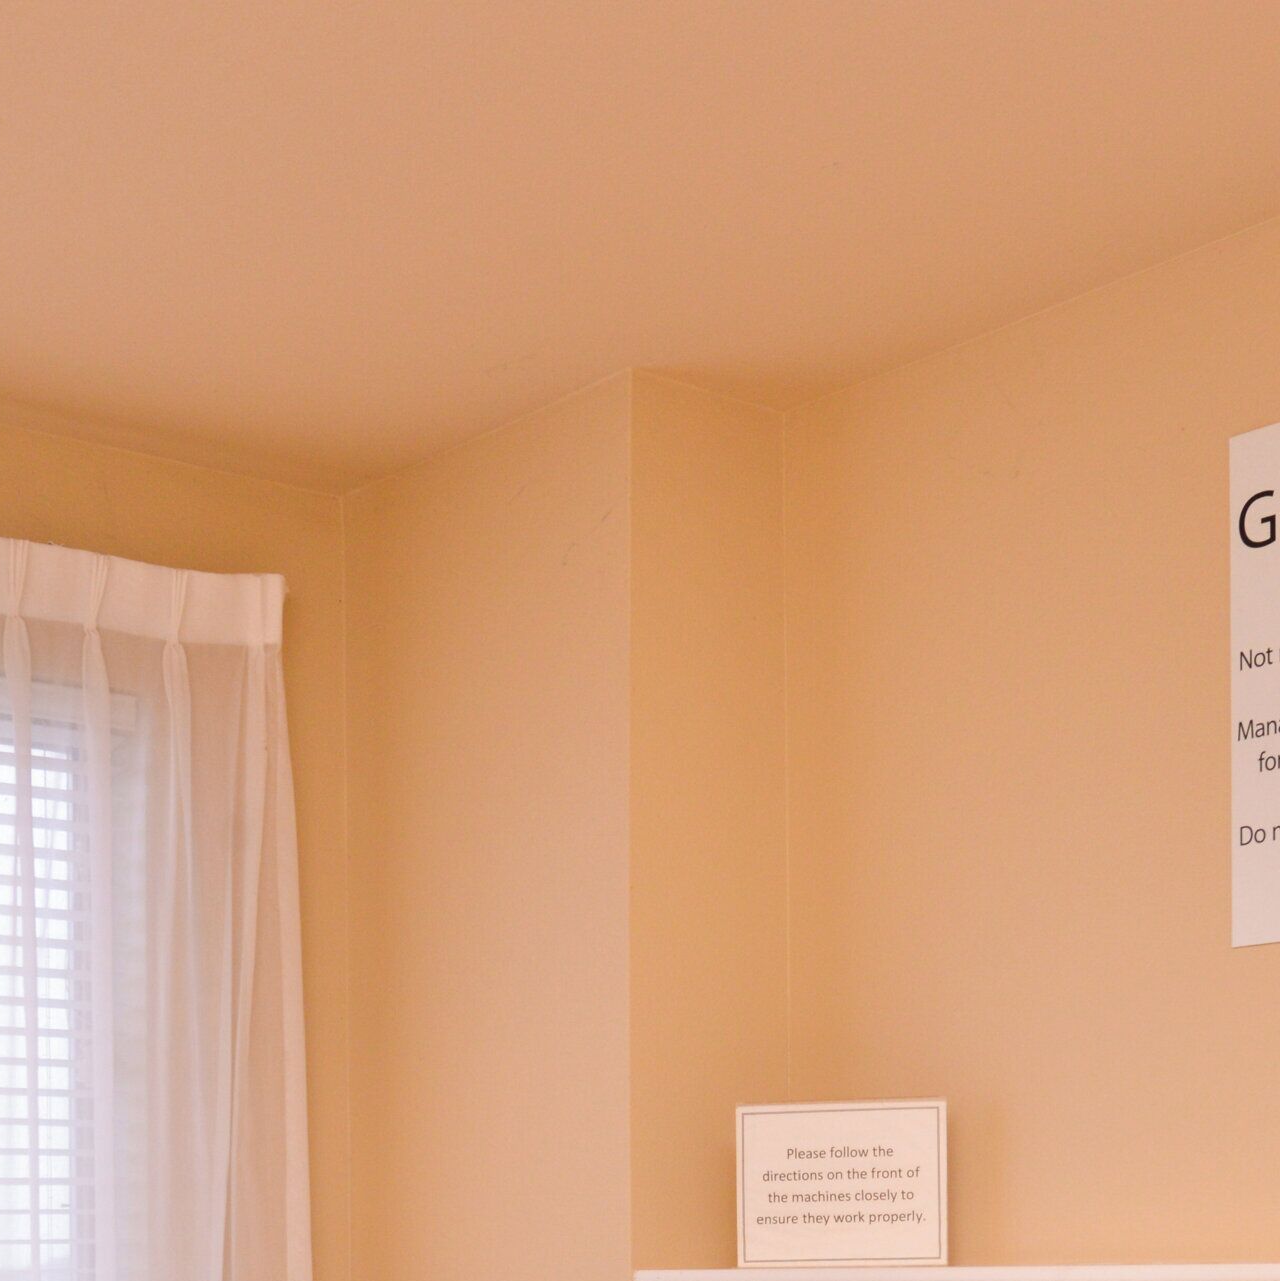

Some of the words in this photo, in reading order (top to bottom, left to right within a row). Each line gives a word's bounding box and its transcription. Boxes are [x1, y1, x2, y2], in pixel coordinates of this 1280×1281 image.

[1238, 646, 1274, 673] Not
[1238, 824, 1268, 848] Do
[786, 1147, 827, 1160] Please
[830, 1145, 869, 1159] follow
[872, 1145, 894, 1158] the
[762, 1170, 824, 1182] directions
[826, 1171, 843, 1181] on
[846, 1167, 868, 1180] the
[871, 1167, 903, 1179] front
[906, 1166, 920, 1178] of
[768, 1191, 788, 1204] the
[791, 1190, 852, 1203] machines
[854, 1188, 898, 1203] closely
[900, 1189, 915, 1201] to
[756, 1215, 799, 1225] ensure
[802, 1212, 831, 1226] they
[833, 1211, 865, 1224] work
[868, 1210, 926, 1225] properly.
